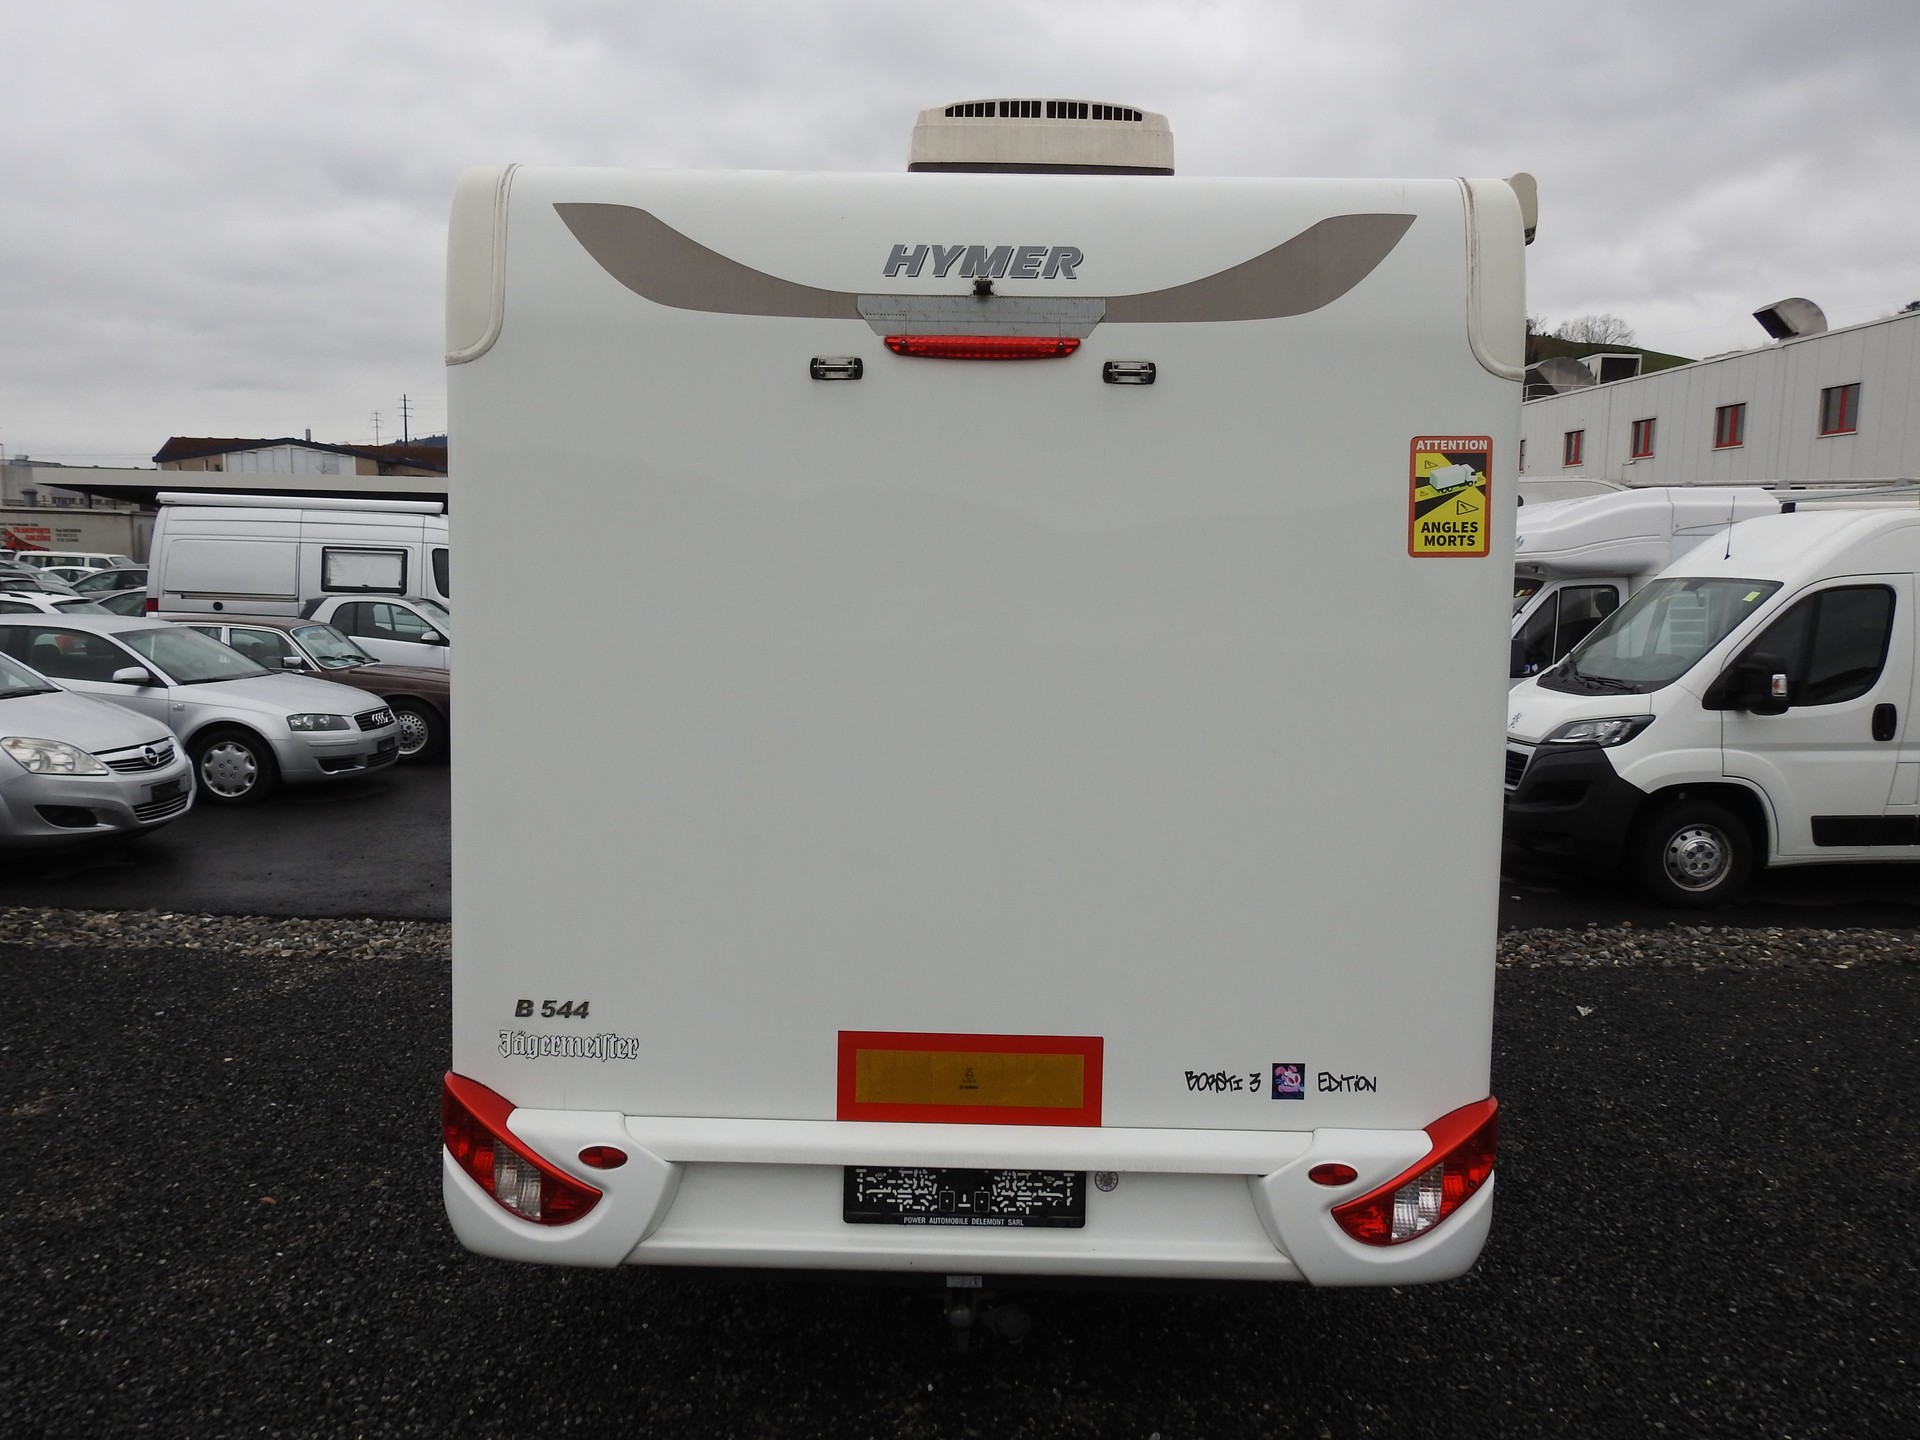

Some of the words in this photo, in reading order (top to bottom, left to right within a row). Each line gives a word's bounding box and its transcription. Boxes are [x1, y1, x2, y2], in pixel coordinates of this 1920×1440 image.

[882, 244, 1084, 279] HYMER
[1416, 440, 1488, 450] ATTENTION
[1421, 521, 1479, 533] ANGLES
[1424, 535, 1476, 547] MORTS
[514, 999, 535, 1018] B
[540, 1000, 590, 1019] 544
[1249, 1072, 1262, 1093] 3
[903, 1216, 926, 1224] POWER
[929, 1217, 969, 1225] AUTOMOBILE
[971, 1217, 1005, 1226] DELEMONT
[1007, 1218, 1025, 1226] SARL
